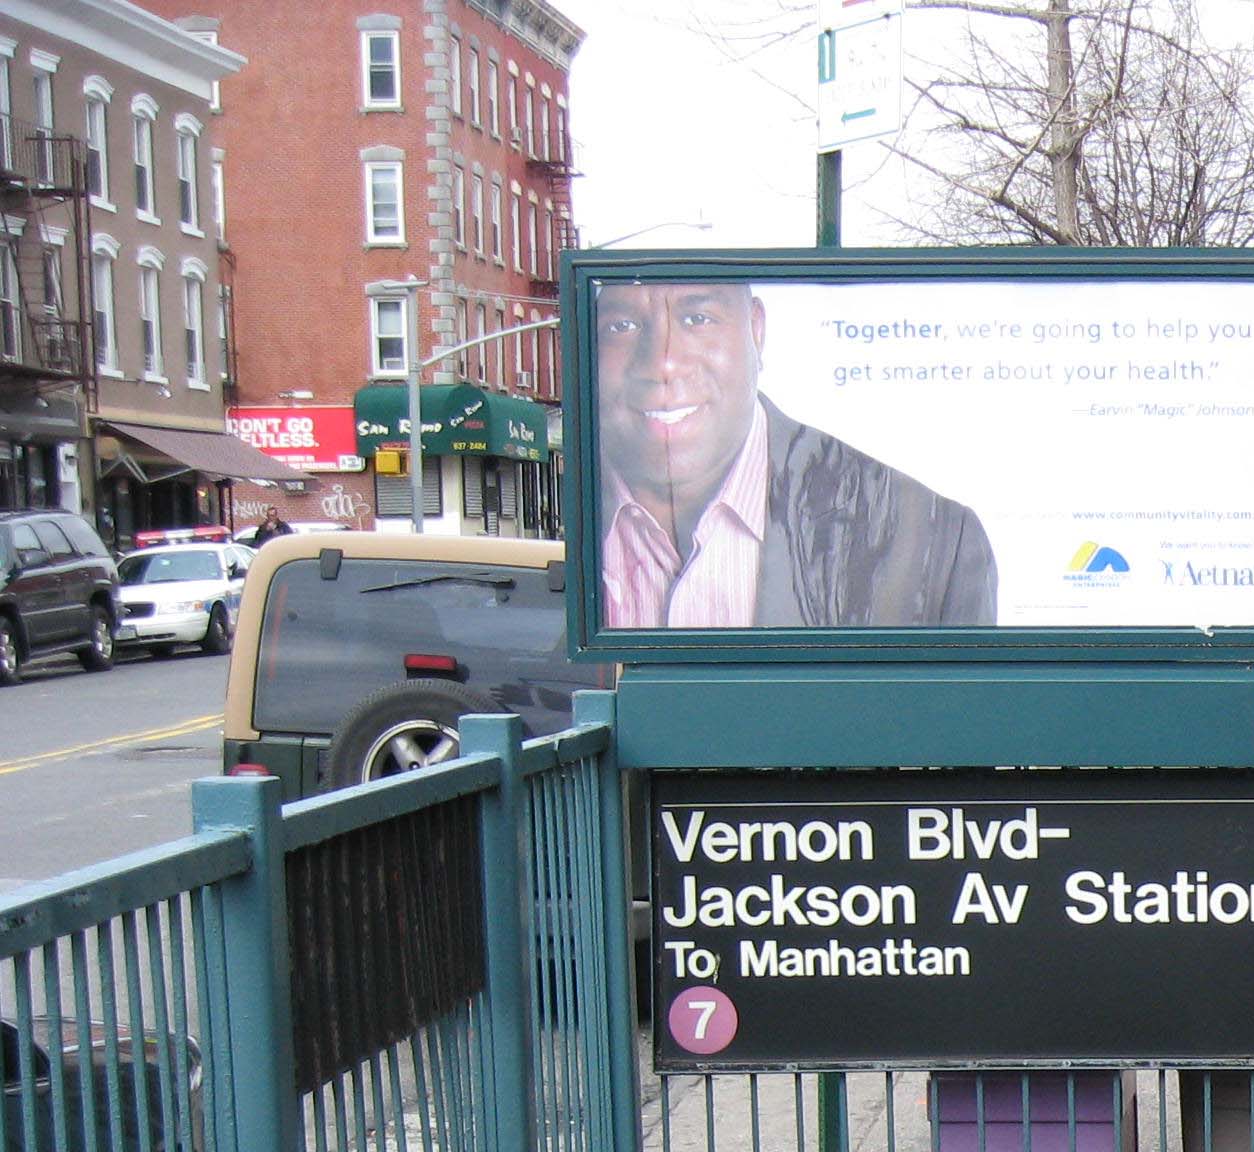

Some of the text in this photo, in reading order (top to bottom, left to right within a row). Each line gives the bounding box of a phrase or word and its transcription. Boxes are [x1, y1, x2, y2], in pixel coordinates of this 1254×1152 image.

[1032, 319, 1102, 343] going
[1111, 321, 1136, 339] to
[1146, 319, 1199, 343] help
[1208, 323, 1252, 344] you
[833, 364, 873, 386] get
[882, 364, 972, 381] smarter
[983, 363, 1054, 382] about
[1063, 366, 1119, 387] your
[226, 417, 314, 434] DON'T GO
[239, 433, 320, 448] ELTLESS.
[661, 808, 1070, 864] Vernon Blvd-
[662, 875, 916, 928] Jackson
[951, 872, 1028, 925] Av
[664, 939, 971, 979] To Manhattan
[687, 1000, 717, 1039] 7
